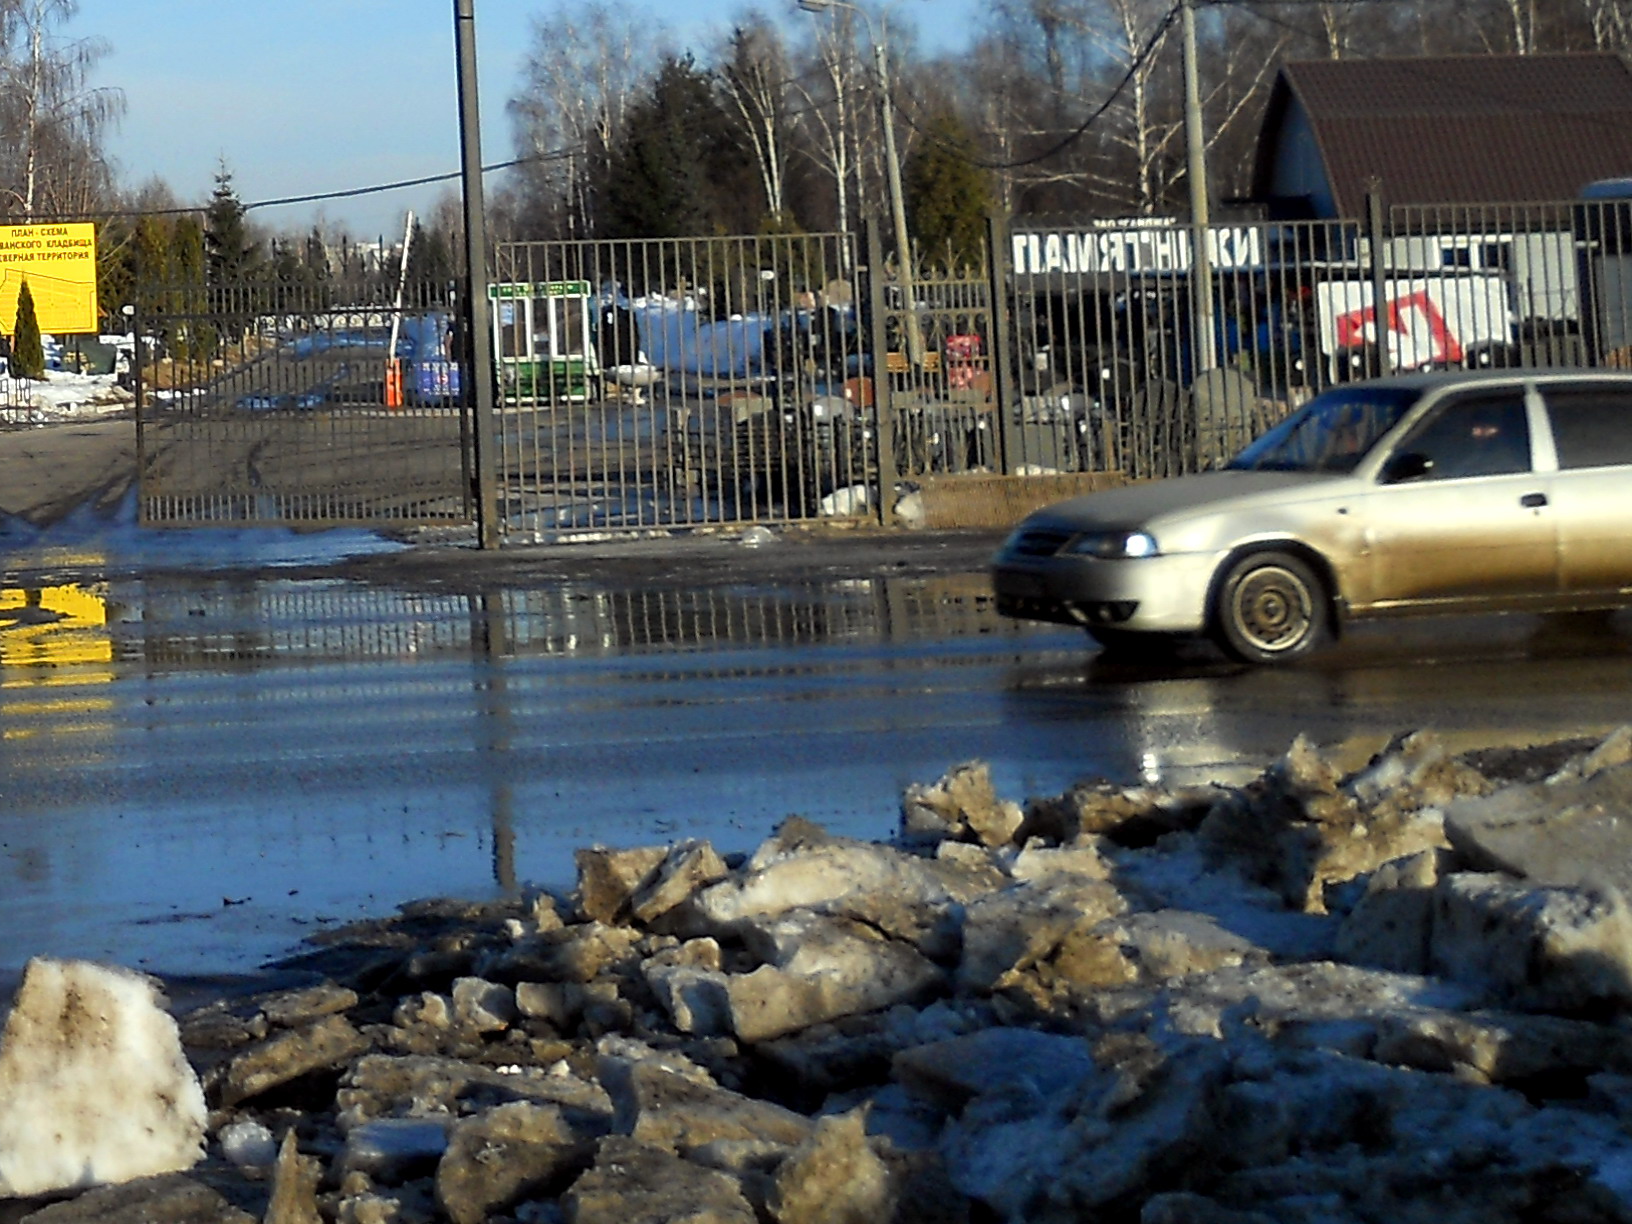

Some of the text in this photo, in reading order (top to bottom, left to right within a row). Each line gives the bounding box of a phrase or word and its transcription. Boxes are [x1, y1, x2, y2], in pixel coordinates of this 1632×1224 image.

[11, 228, 34, 238] ПЛАН
[40, 227, 68, 237] СХЕМА
[46, 239, 92, 248] КЛАДБИЩА
[37, 251, 89, 261] ТЕРРИТОРИЯ
